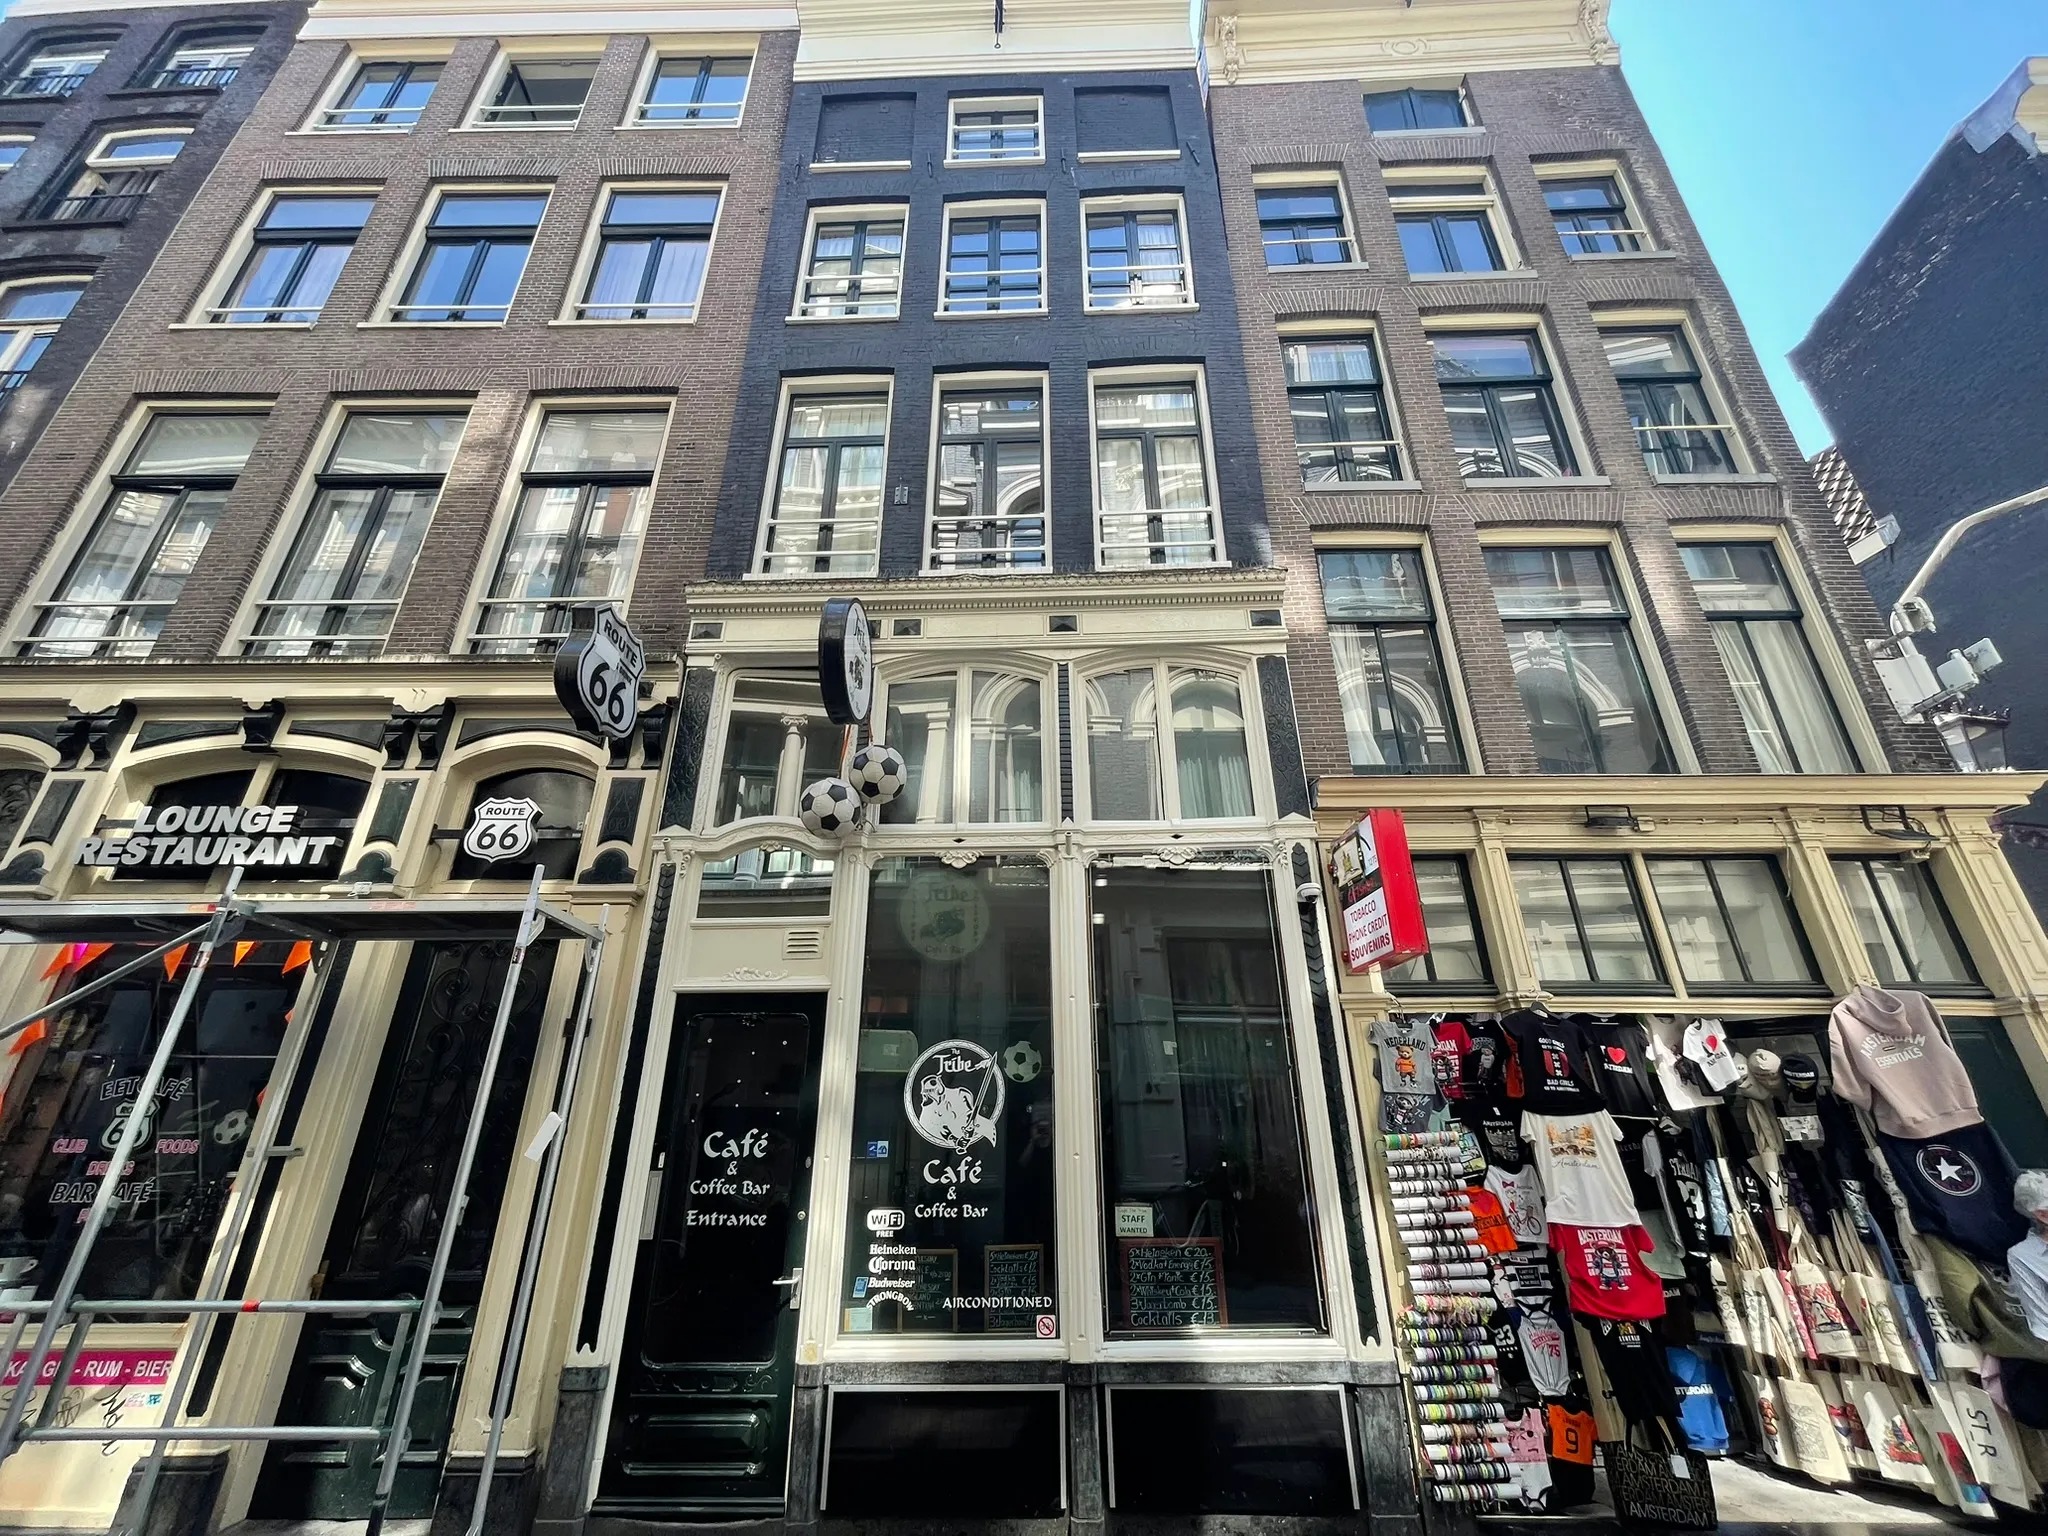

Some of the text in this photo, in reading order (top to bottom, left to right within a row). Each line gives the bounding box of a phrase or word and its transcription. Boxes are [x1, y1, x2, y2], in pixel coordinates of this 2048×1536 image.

[603, 618, 638, 669] ROUTE
[589, 662, 627, 724] 66
[132, 805, 299, 833] LOUNGE
[486, 807, 526, 816] ROUTE
[477, 823, 519, 850] 66
[74, 836, 336, 865] RESTAURANT
[1350, 899, 1377, 923] TOBACCO
[1348, 913, 1388, 944] PHONE CREDIT
[1350, 932, 1390, 961] SOUVENIRS
[1383, 1036, 1427, 1052] NEDERLAND
[932, 1054, 973, 1075] Tribe
[1875, 1046, 1924, 1068] ESSENTIALS
[52, 1138, 88, 1154] CLUB
[154, 1138, 200, 1154] FOODS
[703, 1128, 769, 1158] Café
[726, 1160, 738, 1175] &
[923, 1156, 983, 1184] Café
[690, 1178, 770, 1195] Coffee Bar
[946, 1186, 957, 1200] &
[686, 1209, 768, 1226] Entrance
[914, 1202, 988, 1218] Coffee Bar
[1121, 1214, 1146, 1223] STAFF
[876, 1230, 894, 1238] FREE
[1577, 1228, 1624, 1246] AMSTERDAM
[869, 1244, 917, 1255] Heineken
[868, 1256, 916, 1274] Corona
[867, 1277, 915, 1289] Budweiser
[865, 1290, 914, 1312] STRONGBOW
[942, 1296, 1053, 1309] AIRCONDITIONED
[1130, 1311, 1183, 1327] Cocktails
[1495, 1324, 1515, 1346] 23
[1549, 1344, 1561, 1358] 75
[83, 1360, 124, 1378] RUM
[133, 1360, 172, 1378] BIER
[1565, 1427, 1579, 1454] 9
[1623, 1472, 1700, 1496] AMSTERDAM
[1630, 1501, 1709, 1527] AMSTERDAM
